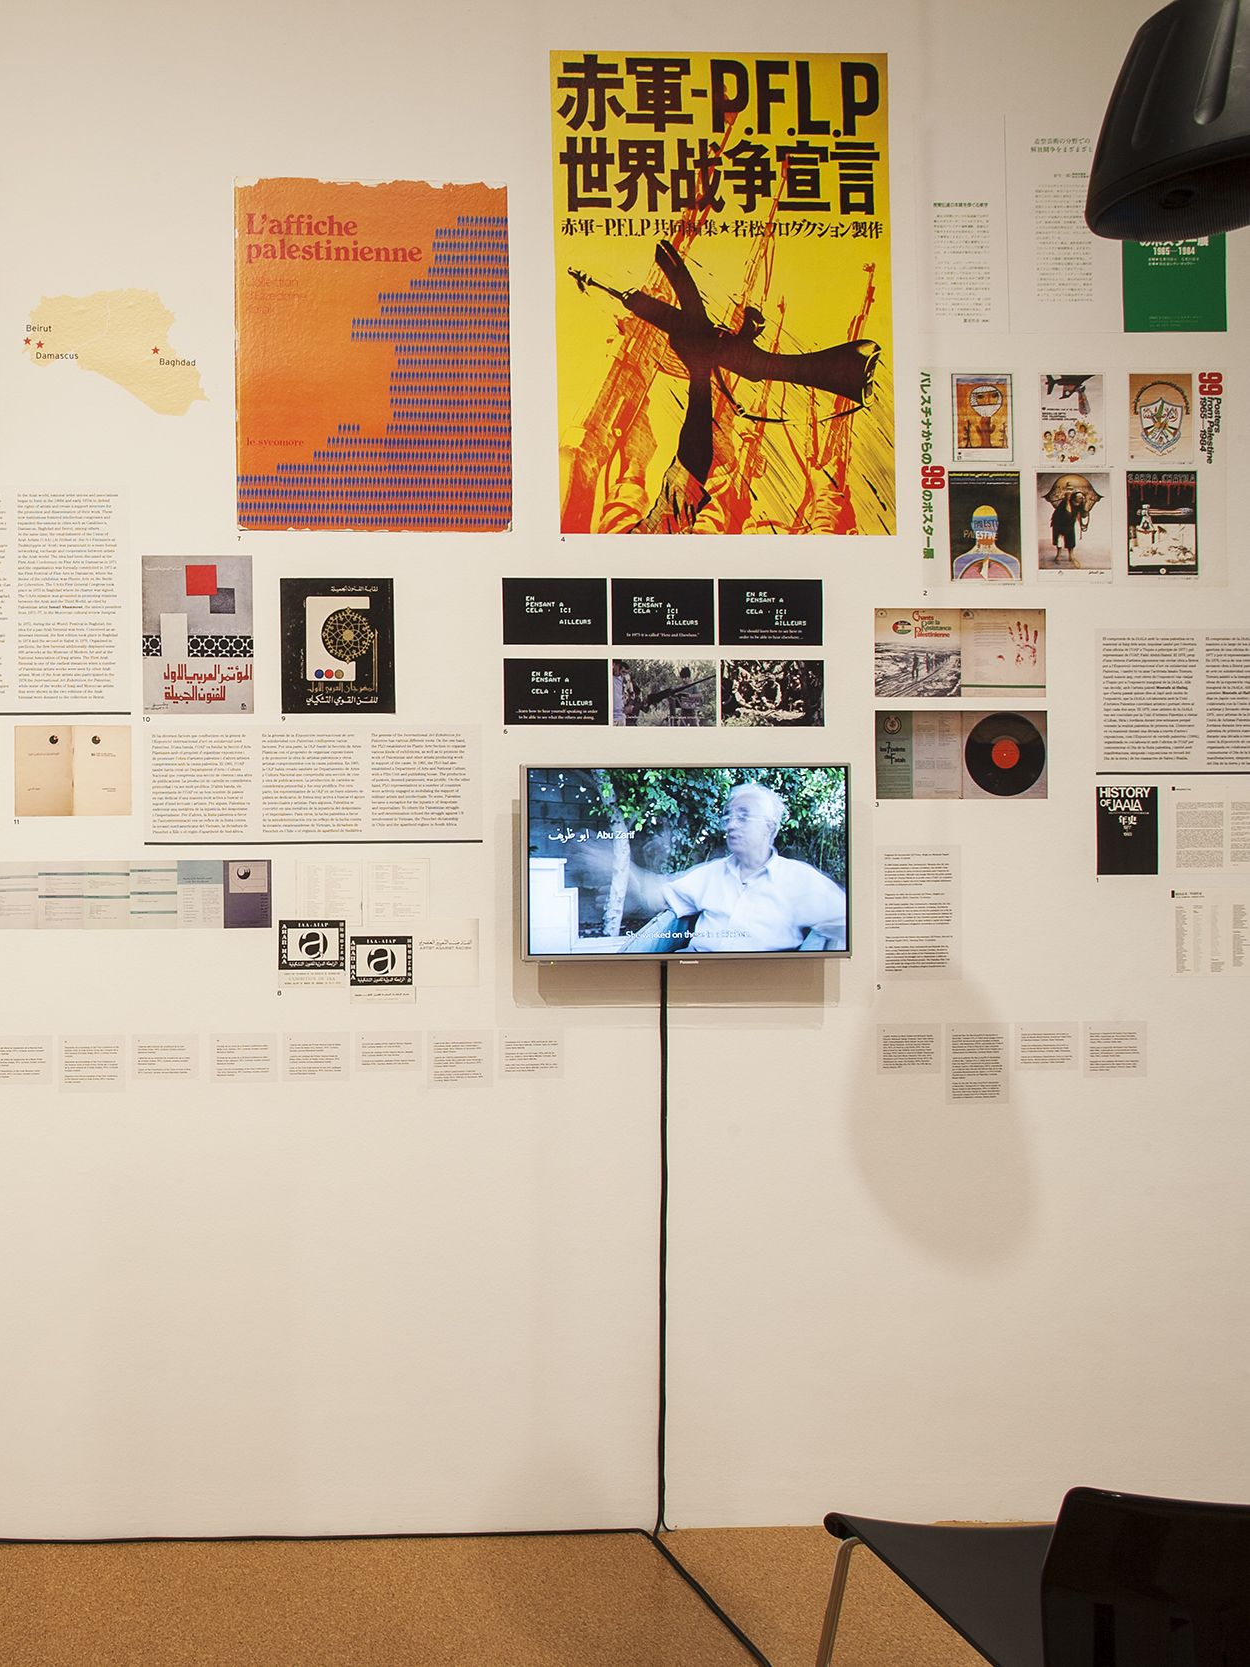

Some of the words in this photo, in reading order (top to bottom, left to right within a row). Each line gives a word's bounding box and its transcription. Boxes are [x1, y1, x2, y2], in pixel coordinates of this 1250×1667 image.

[246, 239, 422, 264] palestinienne
[26, 324, 52, 332] Beirut
[36, 352, 79, 360] Damascus
[160, 358, 196, 367] Baghdad
[1198, 372, 1223, 395] 99
[1214, 397, 1222, 433] Posters
[246, 437, 255, 446] le
[258, 440, 304, 448] sycomore
[1206, 420, 1214, 464] Palestine
[912, 611, 934, 622] Chants
[914, 627, 950, 638] Palestinienne
[1100, 787, 1150, 797] HISTORY
[1100, 799, 1111, 807] OF
[596, 831, 614, 839] Abu
[615, 830, 635, 839] Zarif
[625, 930, 641, 938] She
[643, 930, 671, 938] worked
